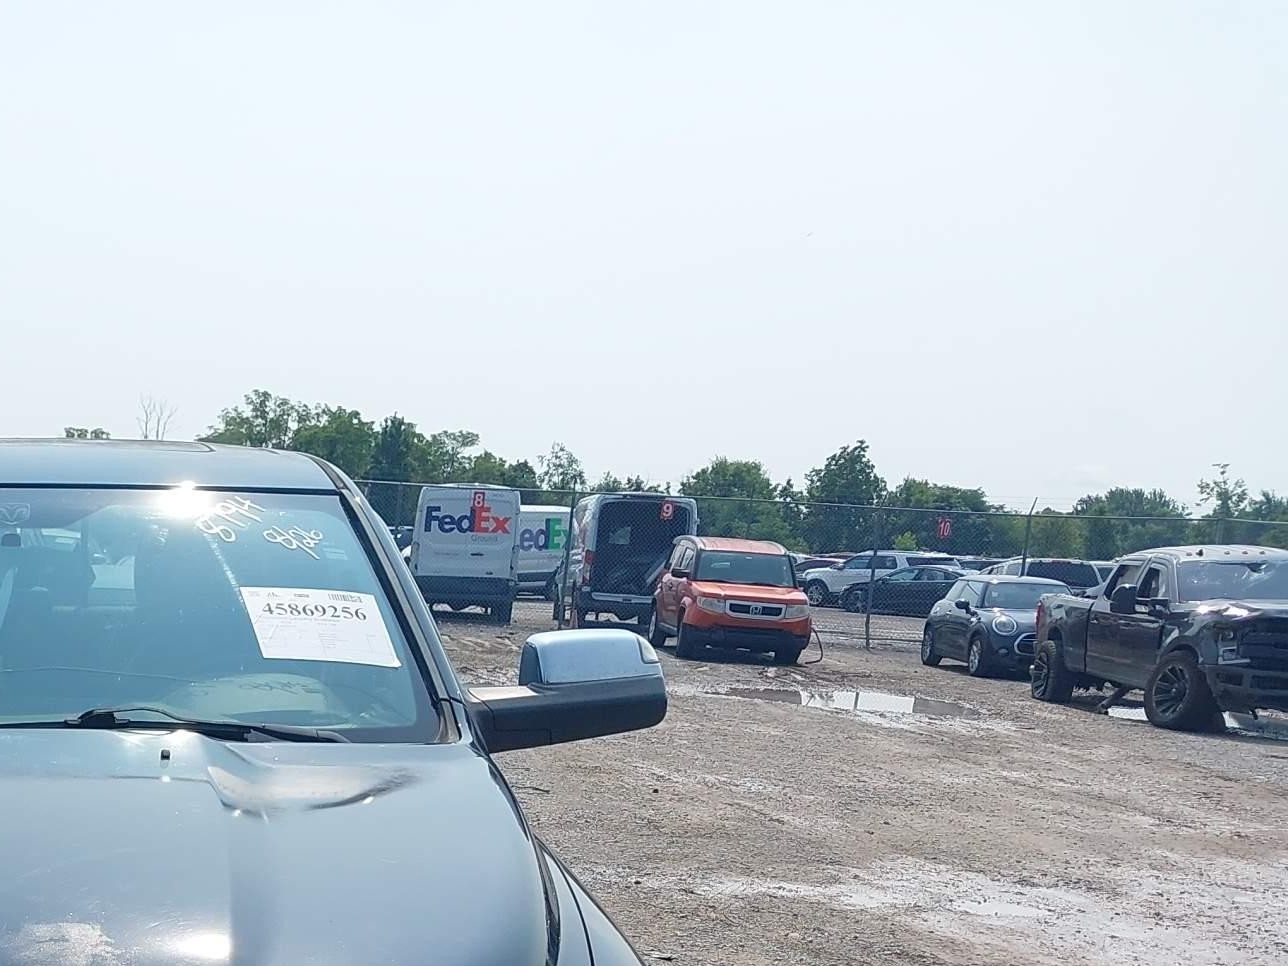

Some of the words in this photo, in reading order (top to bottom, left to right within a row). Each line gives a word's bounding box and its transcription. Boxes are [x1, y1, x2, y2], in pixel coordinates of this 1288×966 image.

[474, 493, 484, 508] 8
[663, 503, 673, 517] 9
[424, 506, 511, 534] FedEx
[520, 518, 569, 551] edE
[940, 521, 951, 537] 10
[262, 602, 367, 621] 45869256
